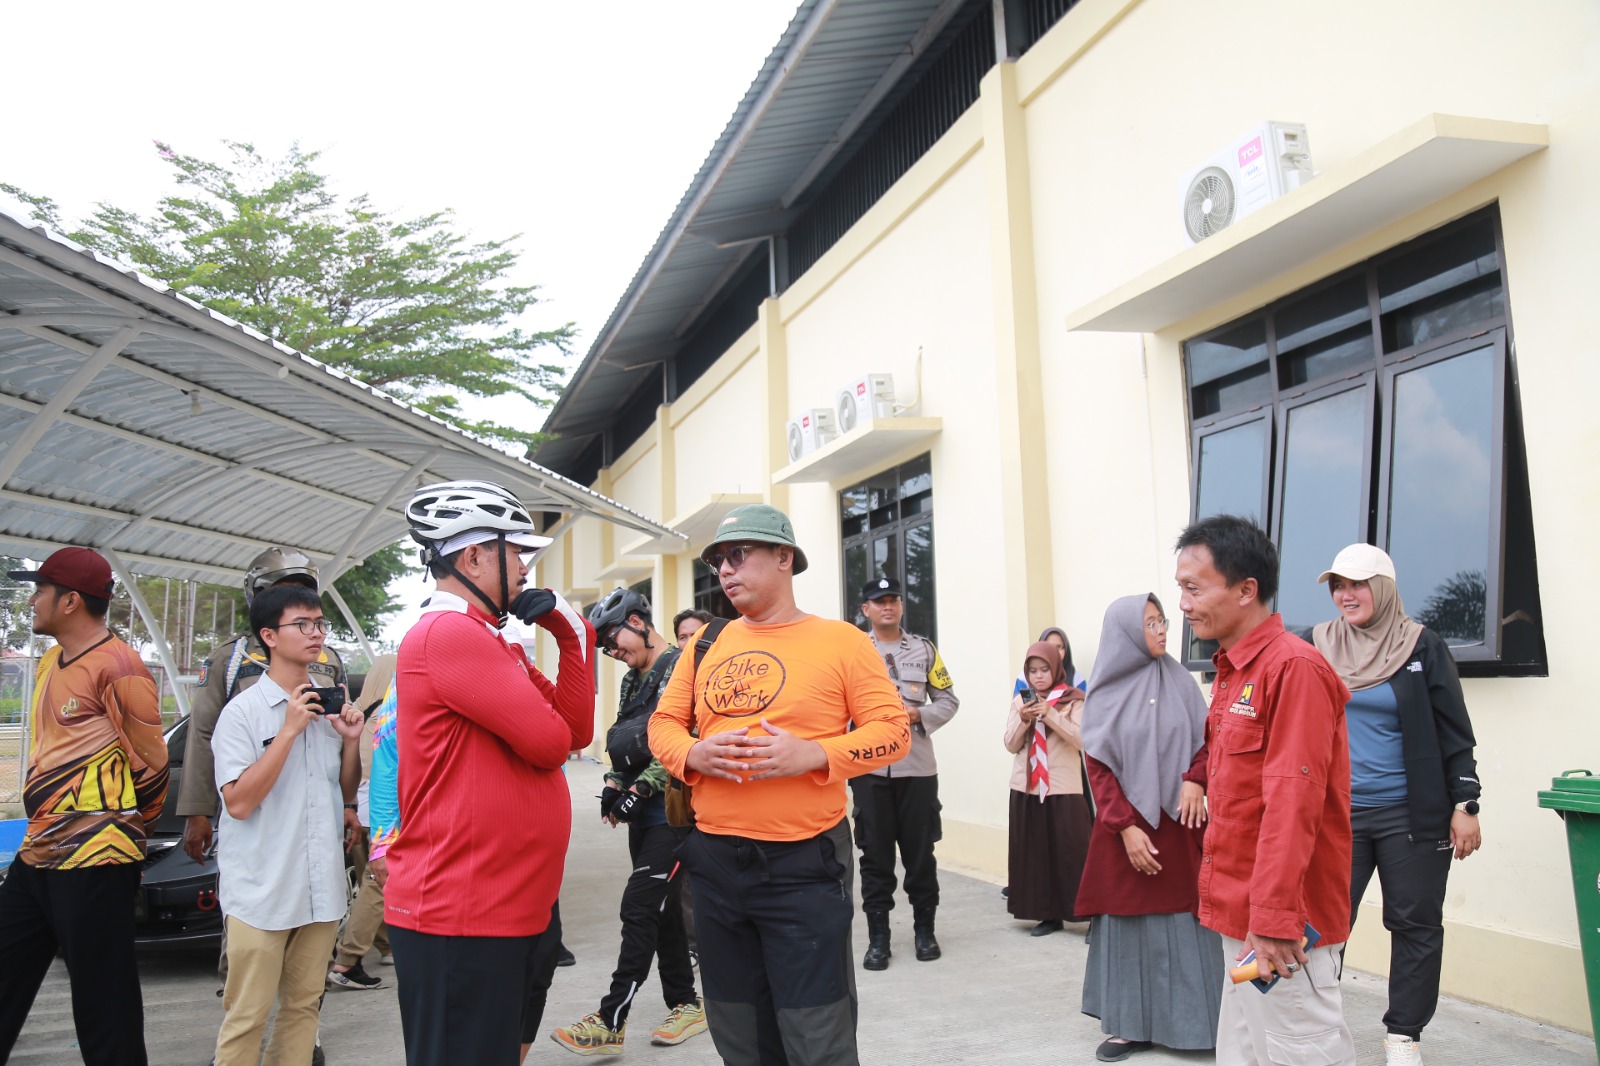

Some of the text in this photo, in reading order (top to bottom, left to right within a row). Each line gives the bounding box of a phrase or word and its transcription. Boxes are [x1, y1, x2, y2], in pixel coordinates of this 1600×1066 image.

[1242, 145, 1258, 160] TCL
[725, 658, 769, 676] bike
[715, 689, 770, 708] work
[848, 741, 900, 762] WORK
[621, 795, 638, 814] FOX
